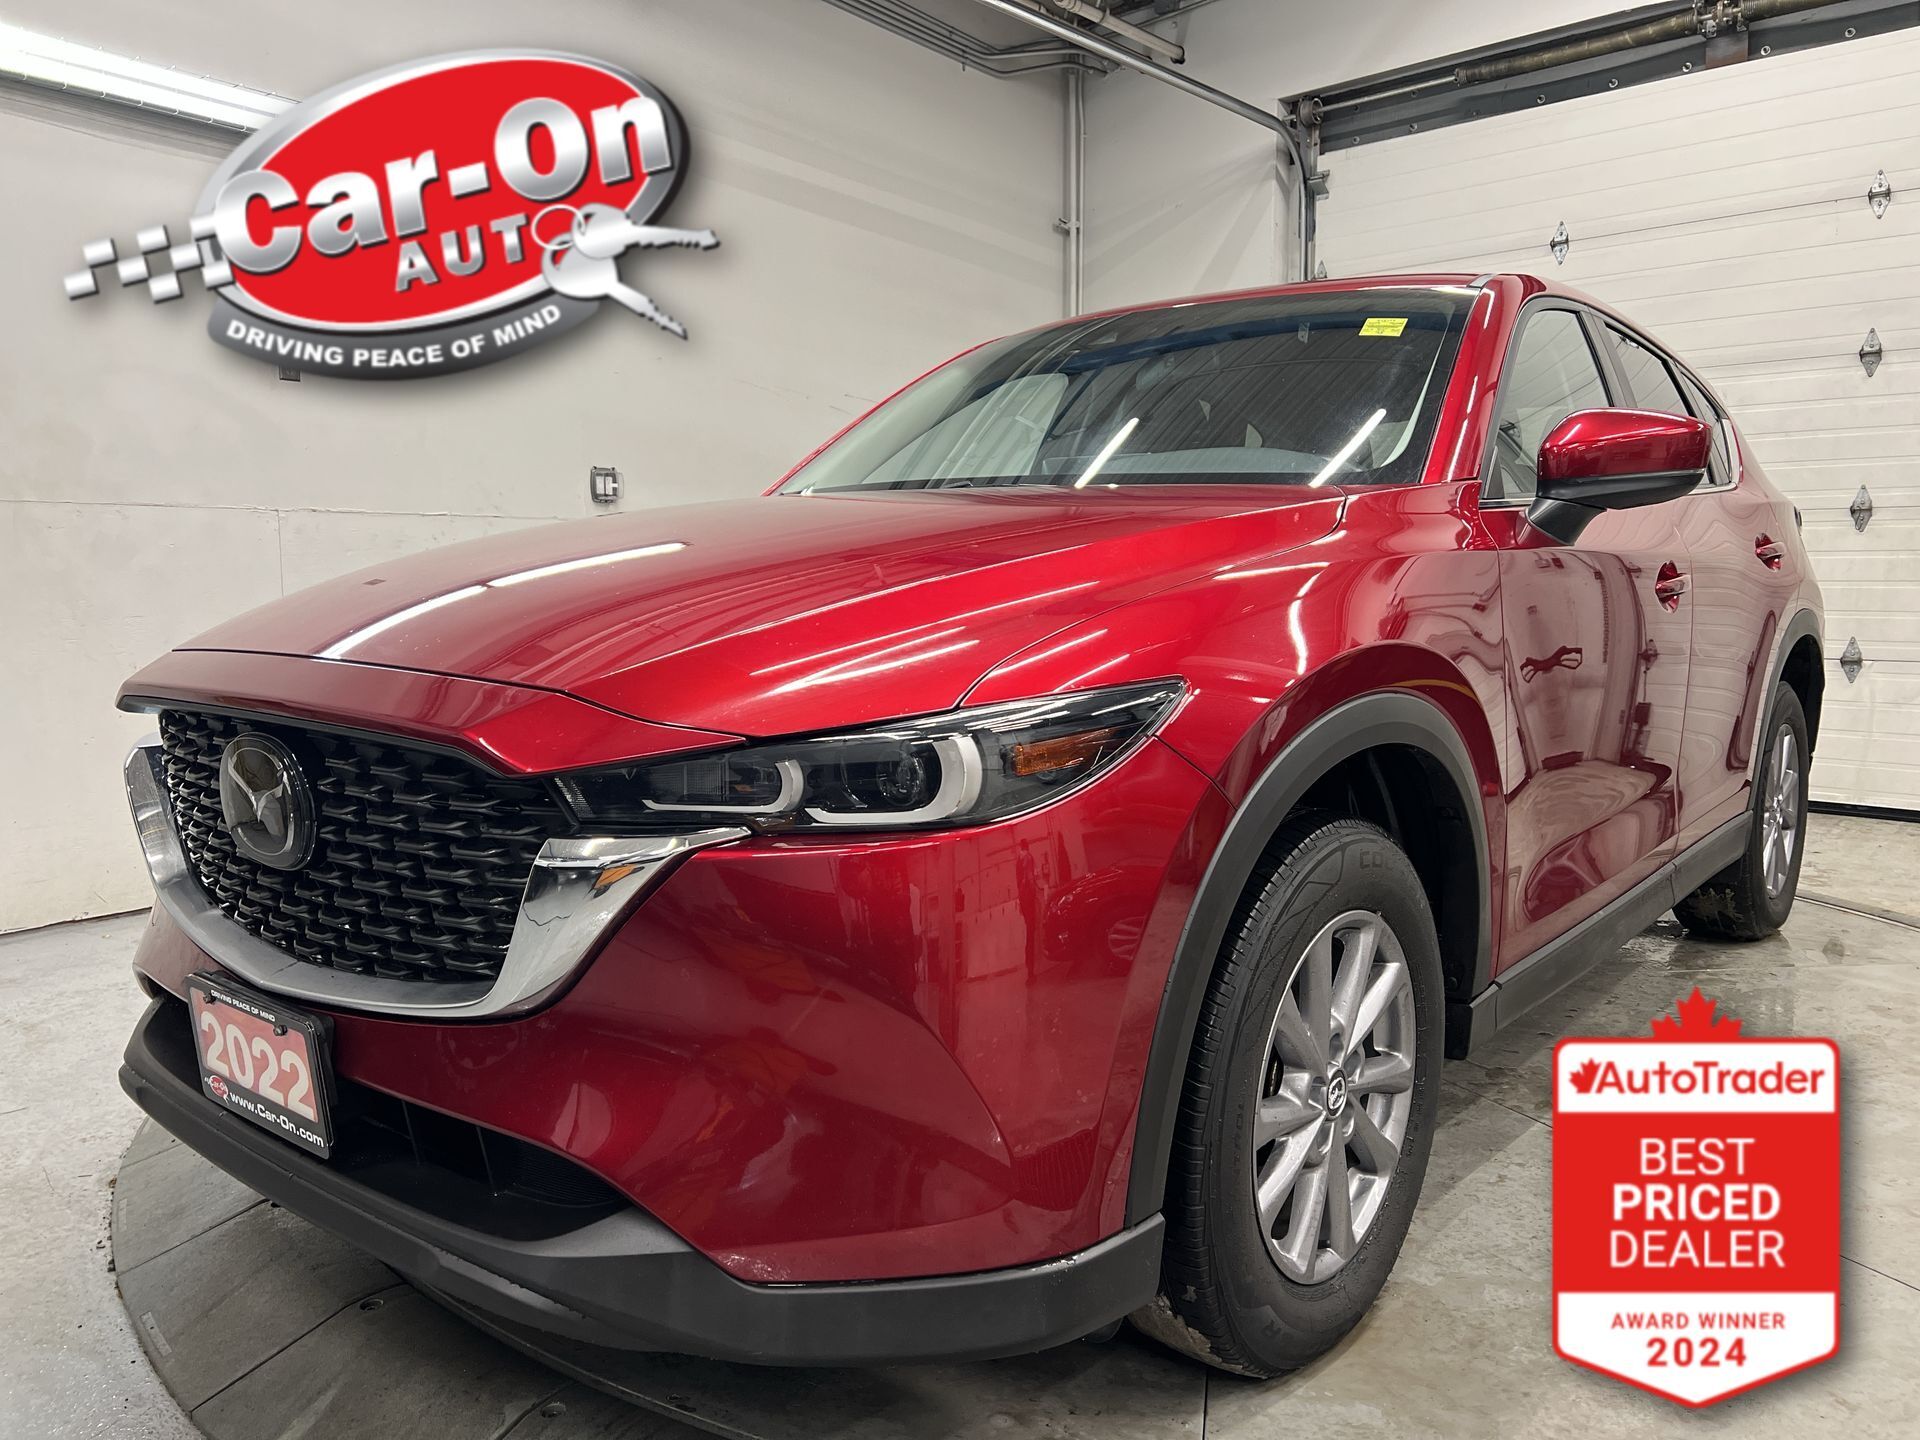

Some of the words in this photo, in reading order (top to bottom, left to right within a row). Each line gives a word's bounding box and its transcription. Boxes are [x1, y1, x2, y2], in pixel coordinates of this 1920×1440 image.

[211, 990, 232, 1004] DRIVING
[232, 999, 250, 1012] PEACE
[251, 1006, 259, 1015] OF
[260, 1010, 276, 1022] MIND
[200, 1011, 316, 1122] 2022
[229, 1092, 325, 1148] www.Car-On.com
